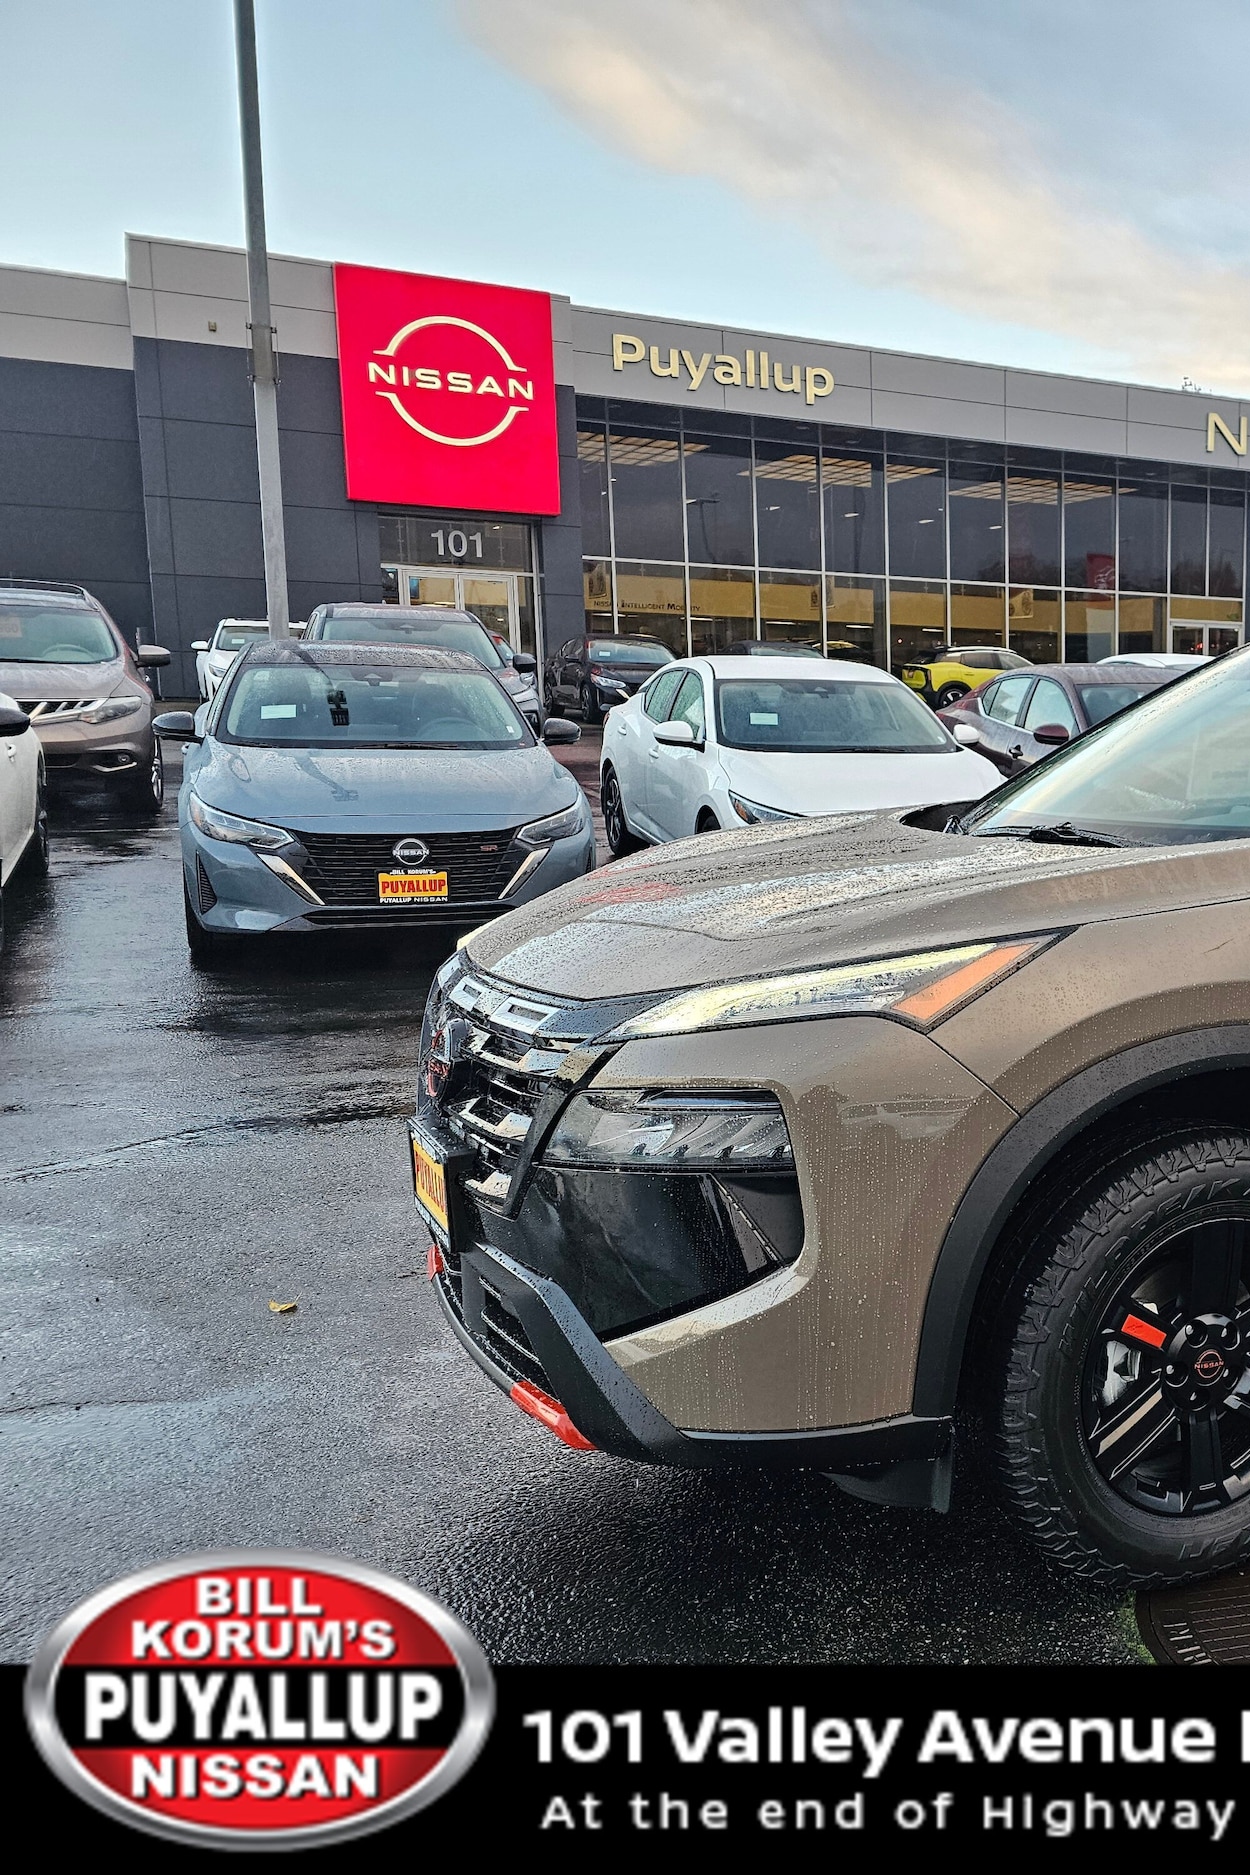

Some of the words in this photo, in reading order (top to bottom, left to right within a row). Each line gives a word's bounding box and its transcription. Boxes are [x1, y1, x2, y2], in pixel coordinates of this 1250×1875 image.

[612, 333, 835, 405] Puyallup
[367, 362, 534, 400] NISSAN
[430, 529, 483, 558] 101
[392, 848, 430, 856] NISSAN
[480, 844, 498, 852] SR
[381, 879, 446, 894] PUYALLUP
[1194, 1360, 1225, 1370] NISSAN
